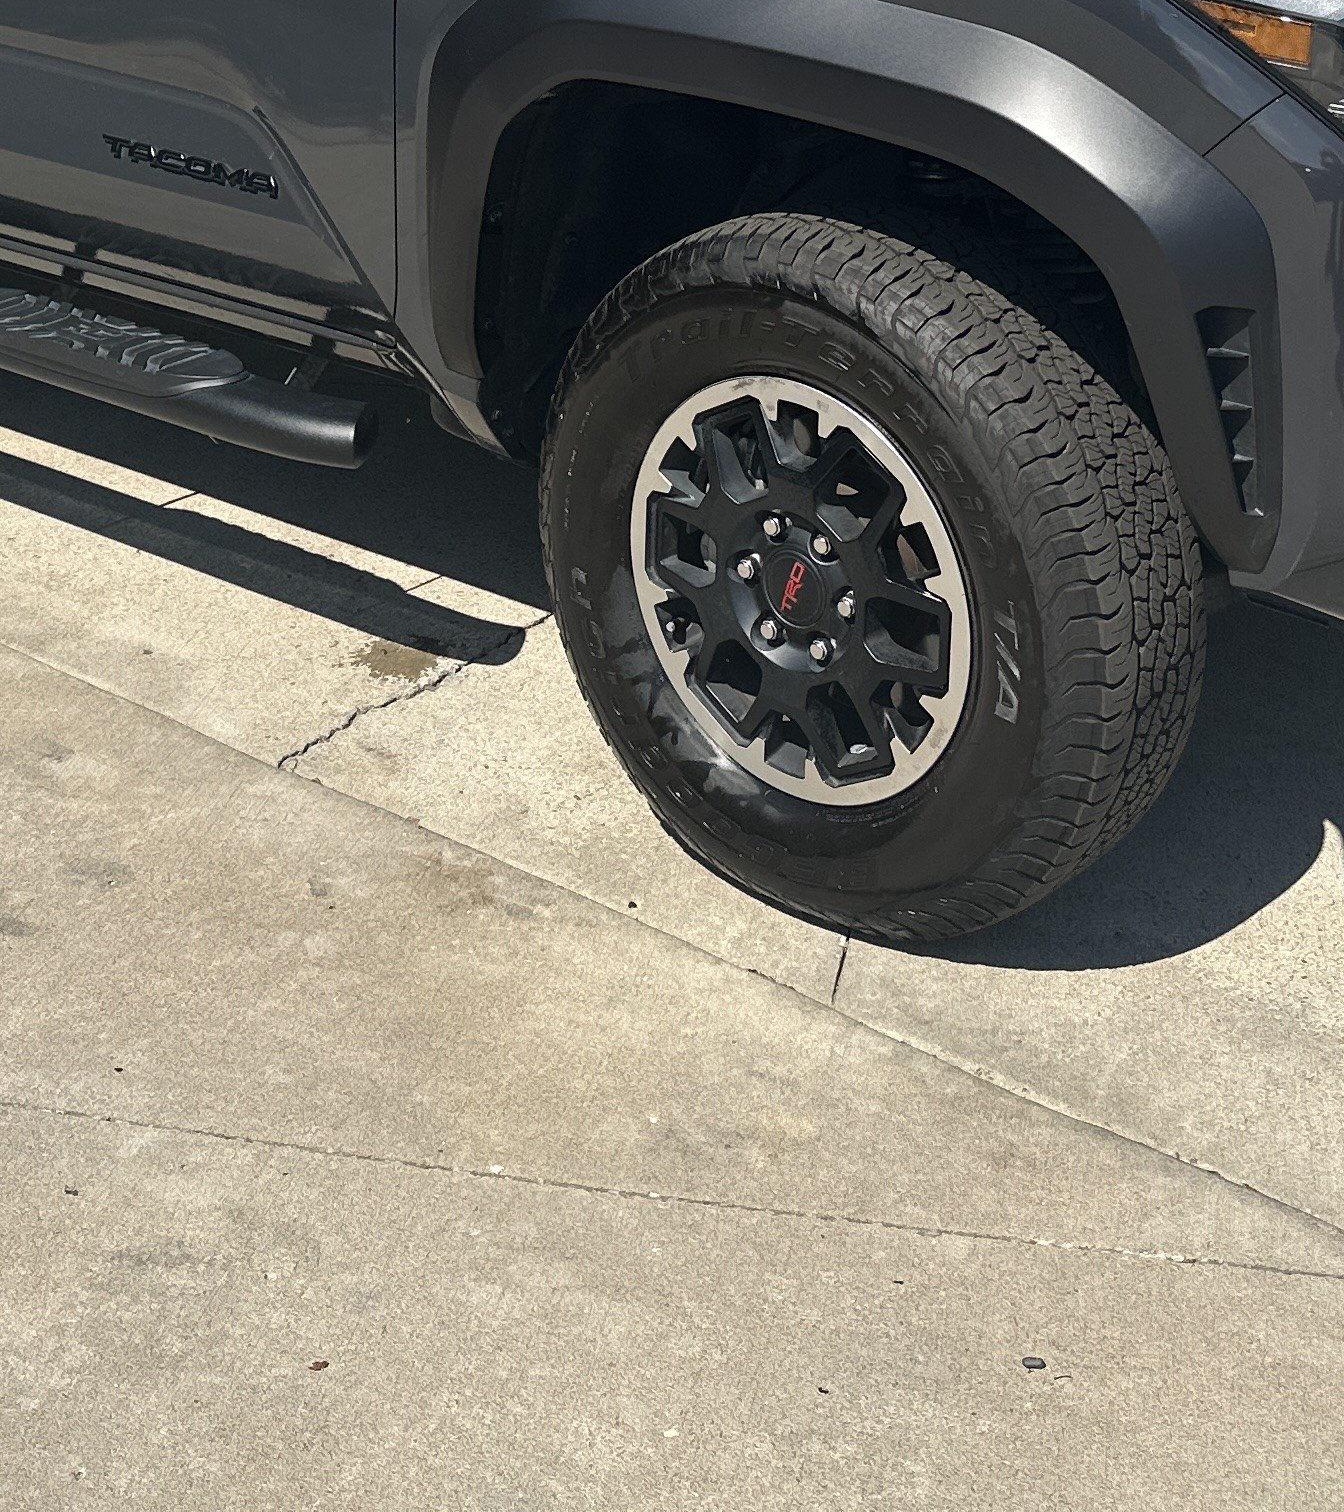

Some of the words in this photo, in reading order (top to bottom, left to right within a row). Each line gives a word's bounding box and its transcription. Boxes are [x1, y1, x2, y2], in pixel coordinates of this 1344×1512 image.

[102, 133, 279, 200] TACOMA
[779, 561, 806, 612] TRD
[993, 599, 1022, 725] T/A
